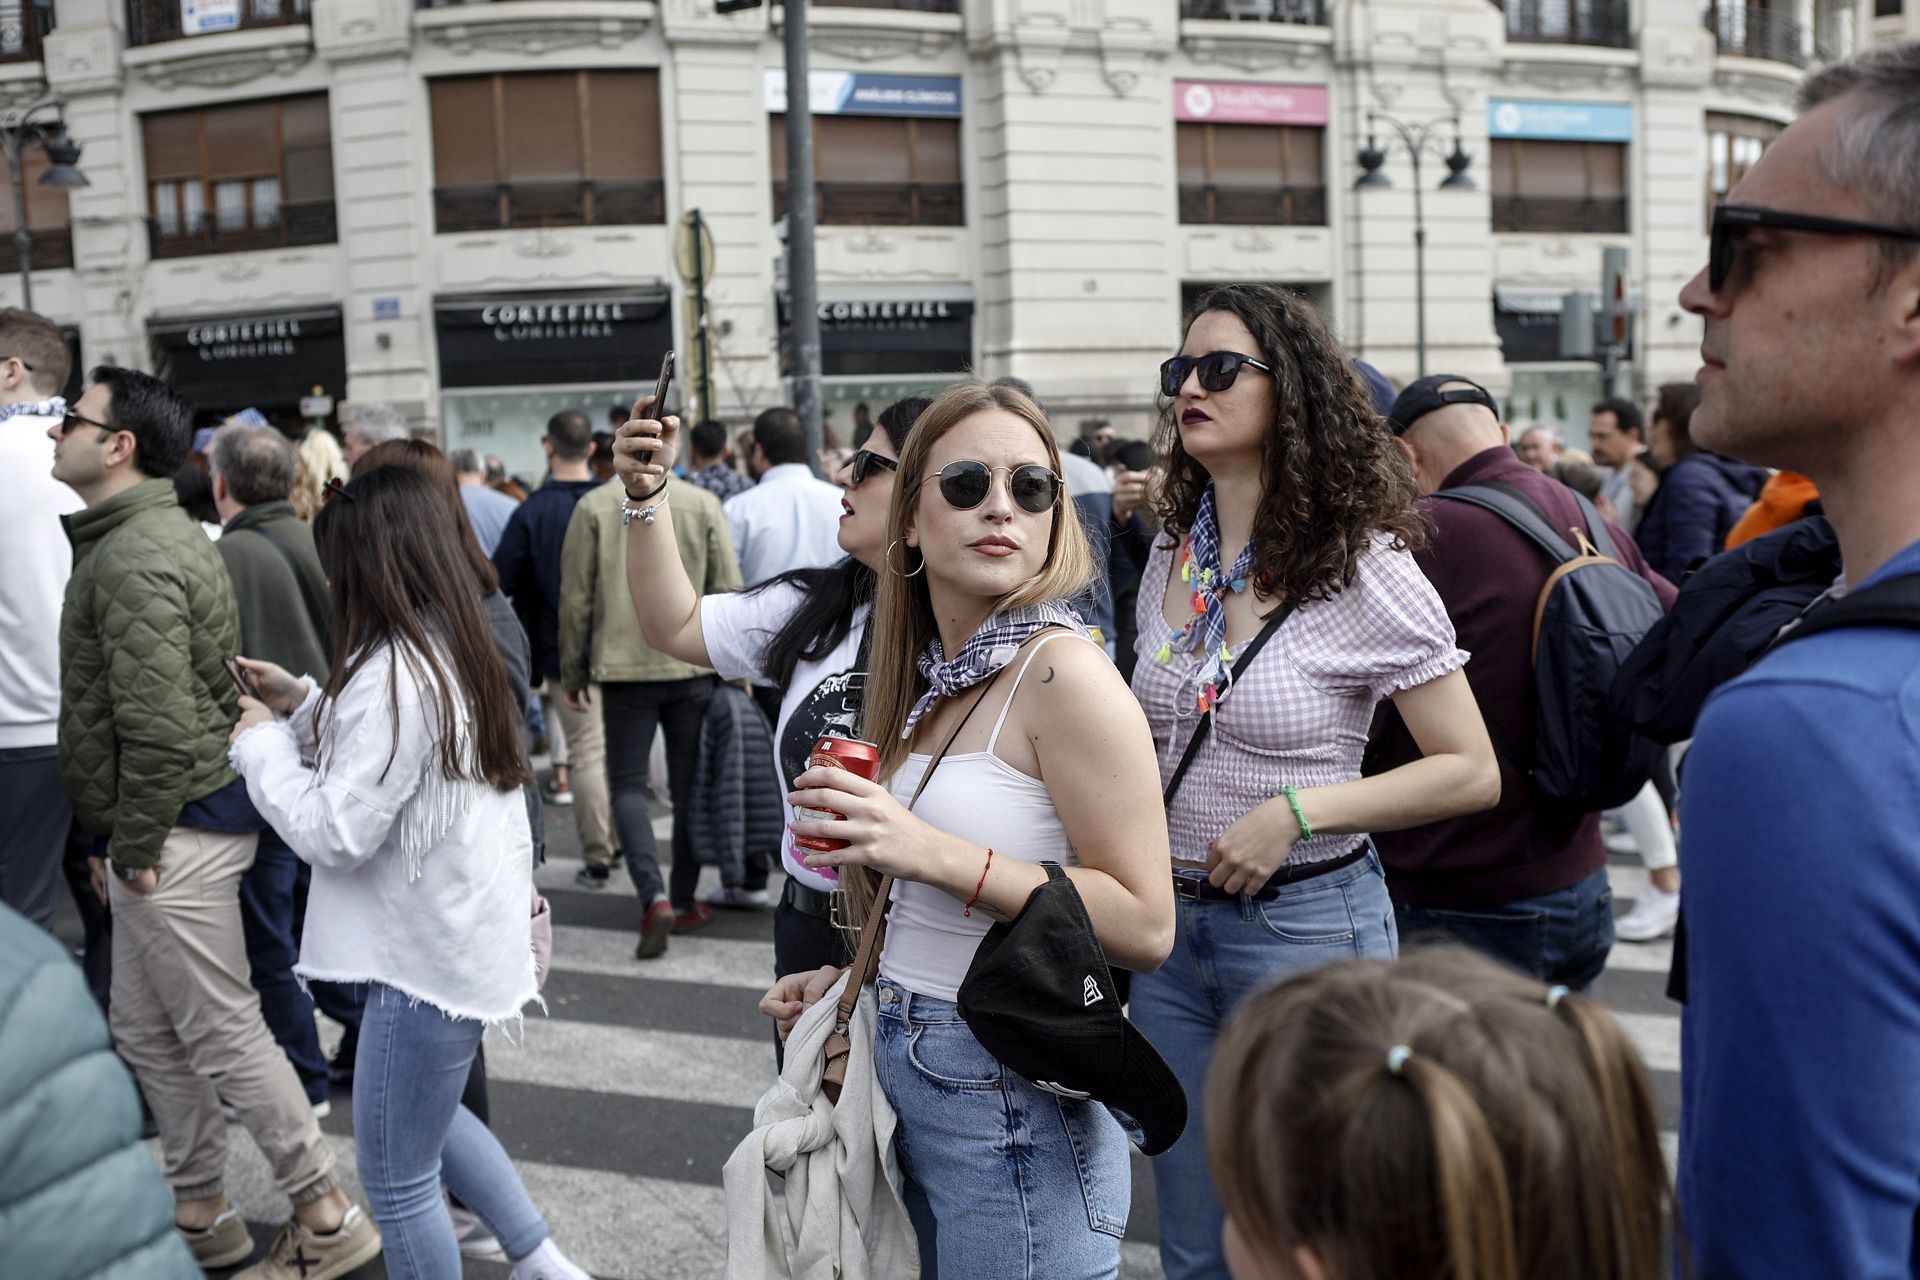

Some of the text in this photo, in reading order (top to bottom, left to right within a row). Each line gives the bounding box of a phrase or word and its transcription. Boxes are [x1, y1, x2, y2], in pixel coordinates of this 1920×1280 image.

[481, 302, 624, 326] CORTEFIEL
[817, 302, 949, 320] CORTEFIEL
[187, 319, 300, 346] CORTEFIEL
